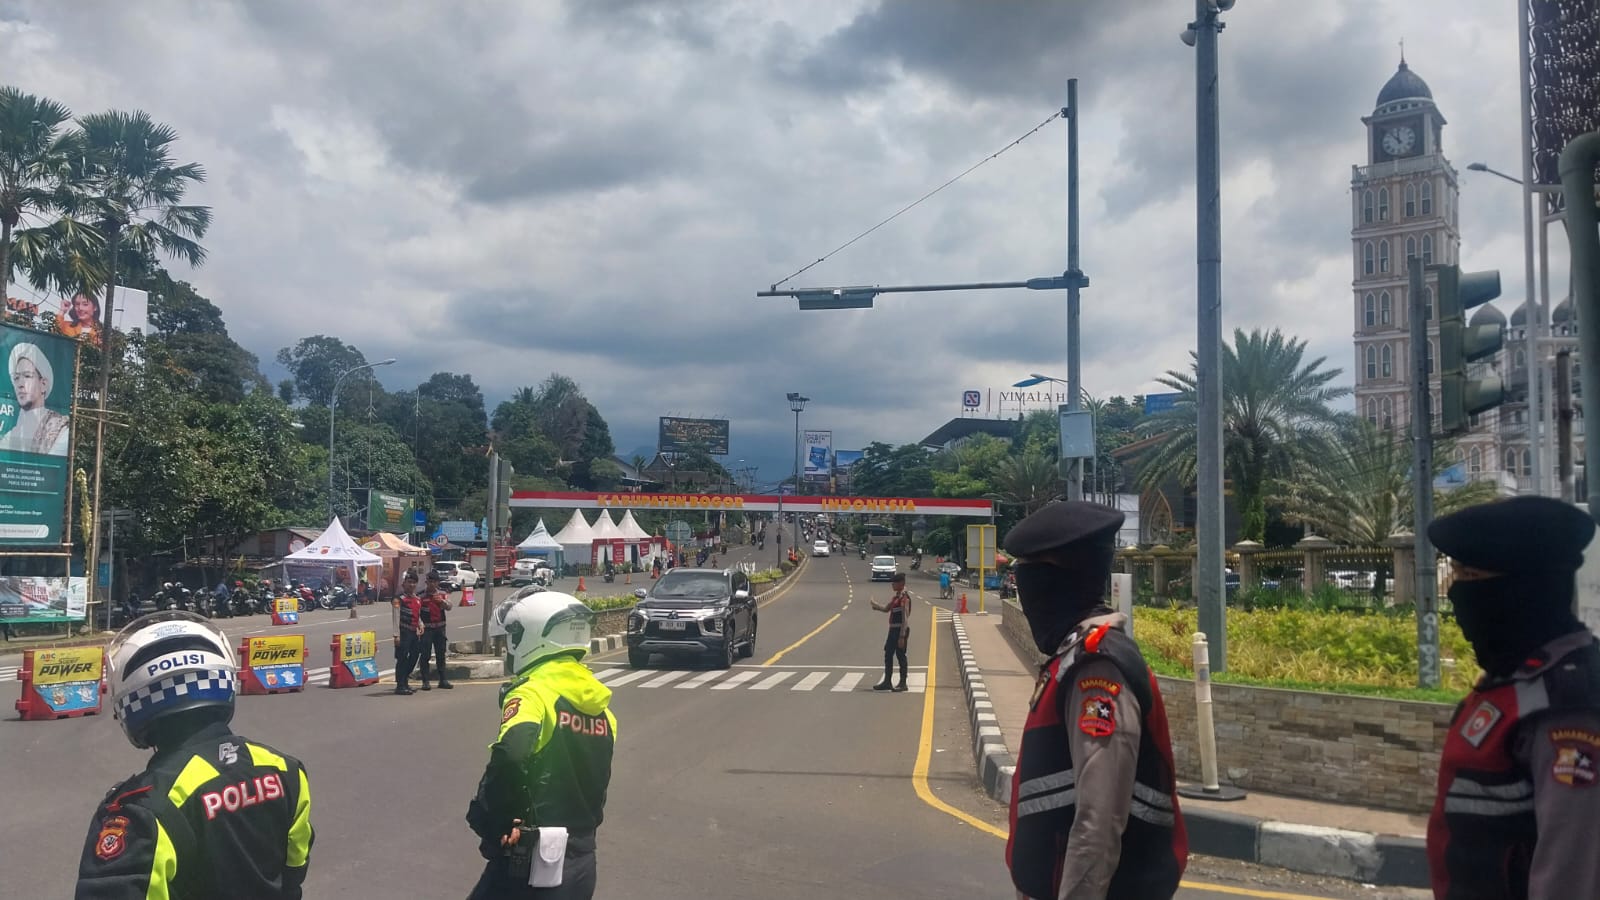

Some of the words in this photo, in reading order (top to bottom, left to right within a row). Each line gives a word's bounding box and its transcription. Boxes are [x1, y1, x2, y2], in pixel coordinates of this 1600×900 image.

[597, 494, 687, 508] KABUPATEN
[689, 496, 745, 509] BOGOR
[821, 497, 917, 512] INDONESIA
[147, 654, 205, 677] POLISI
[252, 649, 297, 662] POWER
[38, 662, 93, 678] POWER
[559, 711, 608, 736] POLISI
[202, 773, 285, 820] POLISI
